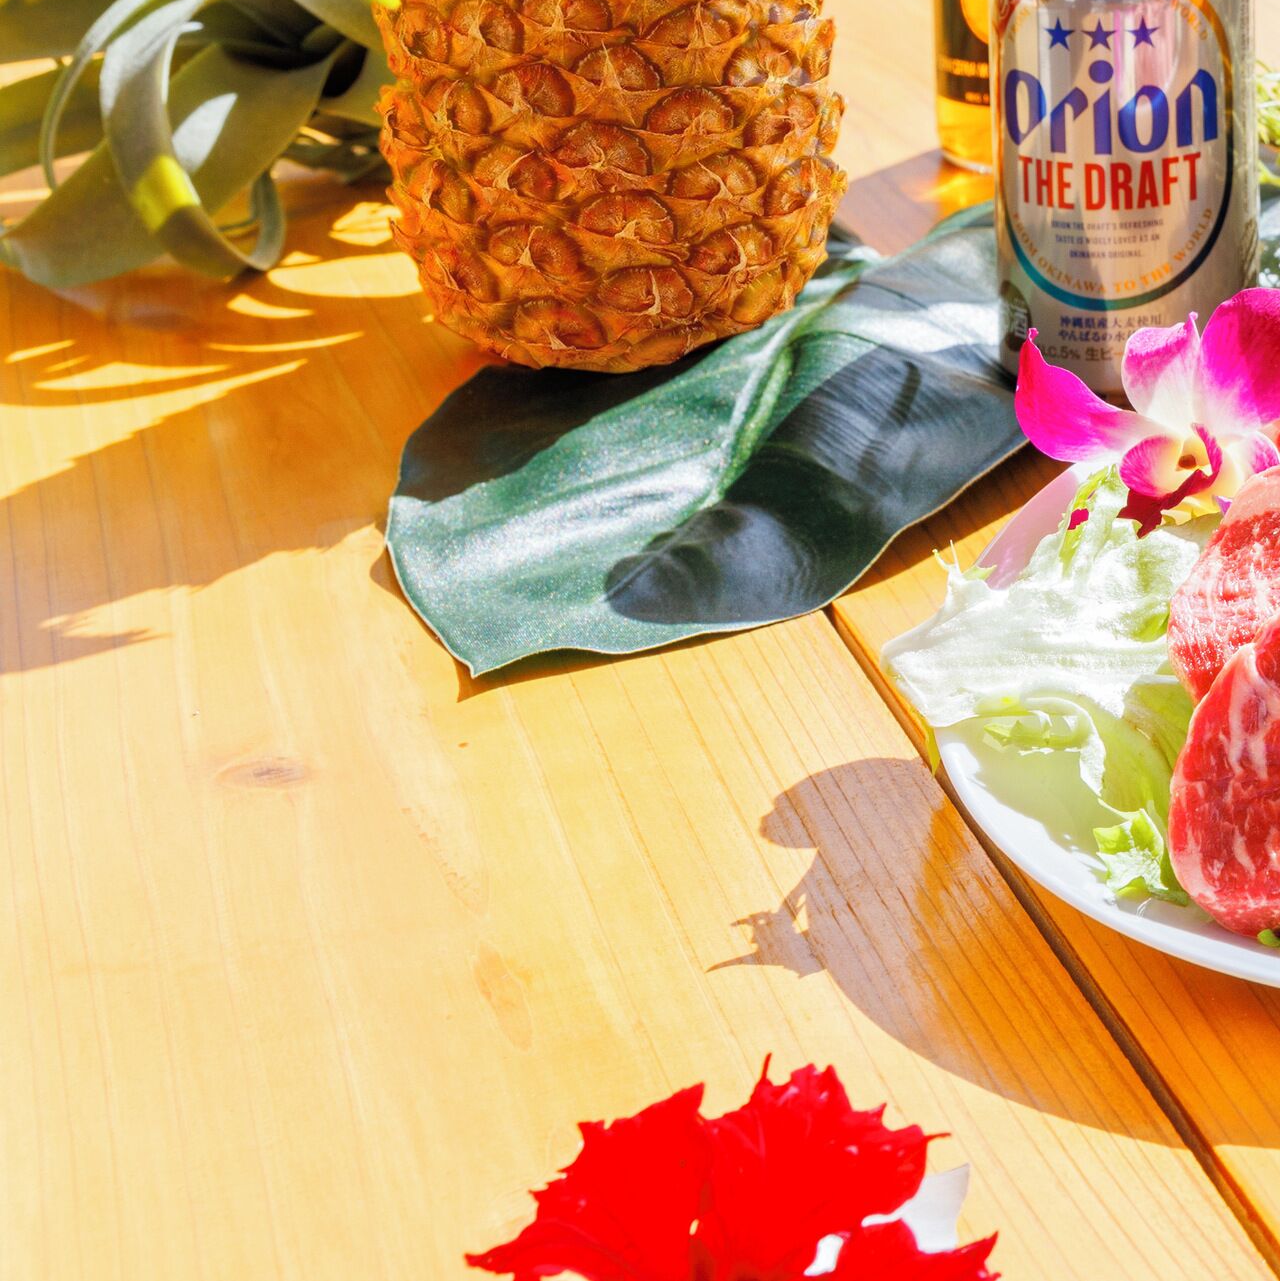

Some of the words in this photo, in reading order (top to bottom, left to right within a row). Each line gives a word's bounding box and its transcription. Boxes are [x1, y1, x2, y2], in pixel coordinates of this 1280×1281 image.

[1004, 59, 1218, 156] Orion
[1017, 154, 1075, 210] THE
[1083, 151, 1202, 211] DRAFT
[1012, 211, 1038, 257] FROM
[1037, 256, 1105, 294] OKINAWA
[1112, 278, 1137, 294] TO
[1139, 261, 1173, 286] THE
[1172, 207, 1213, 262] WORLD
